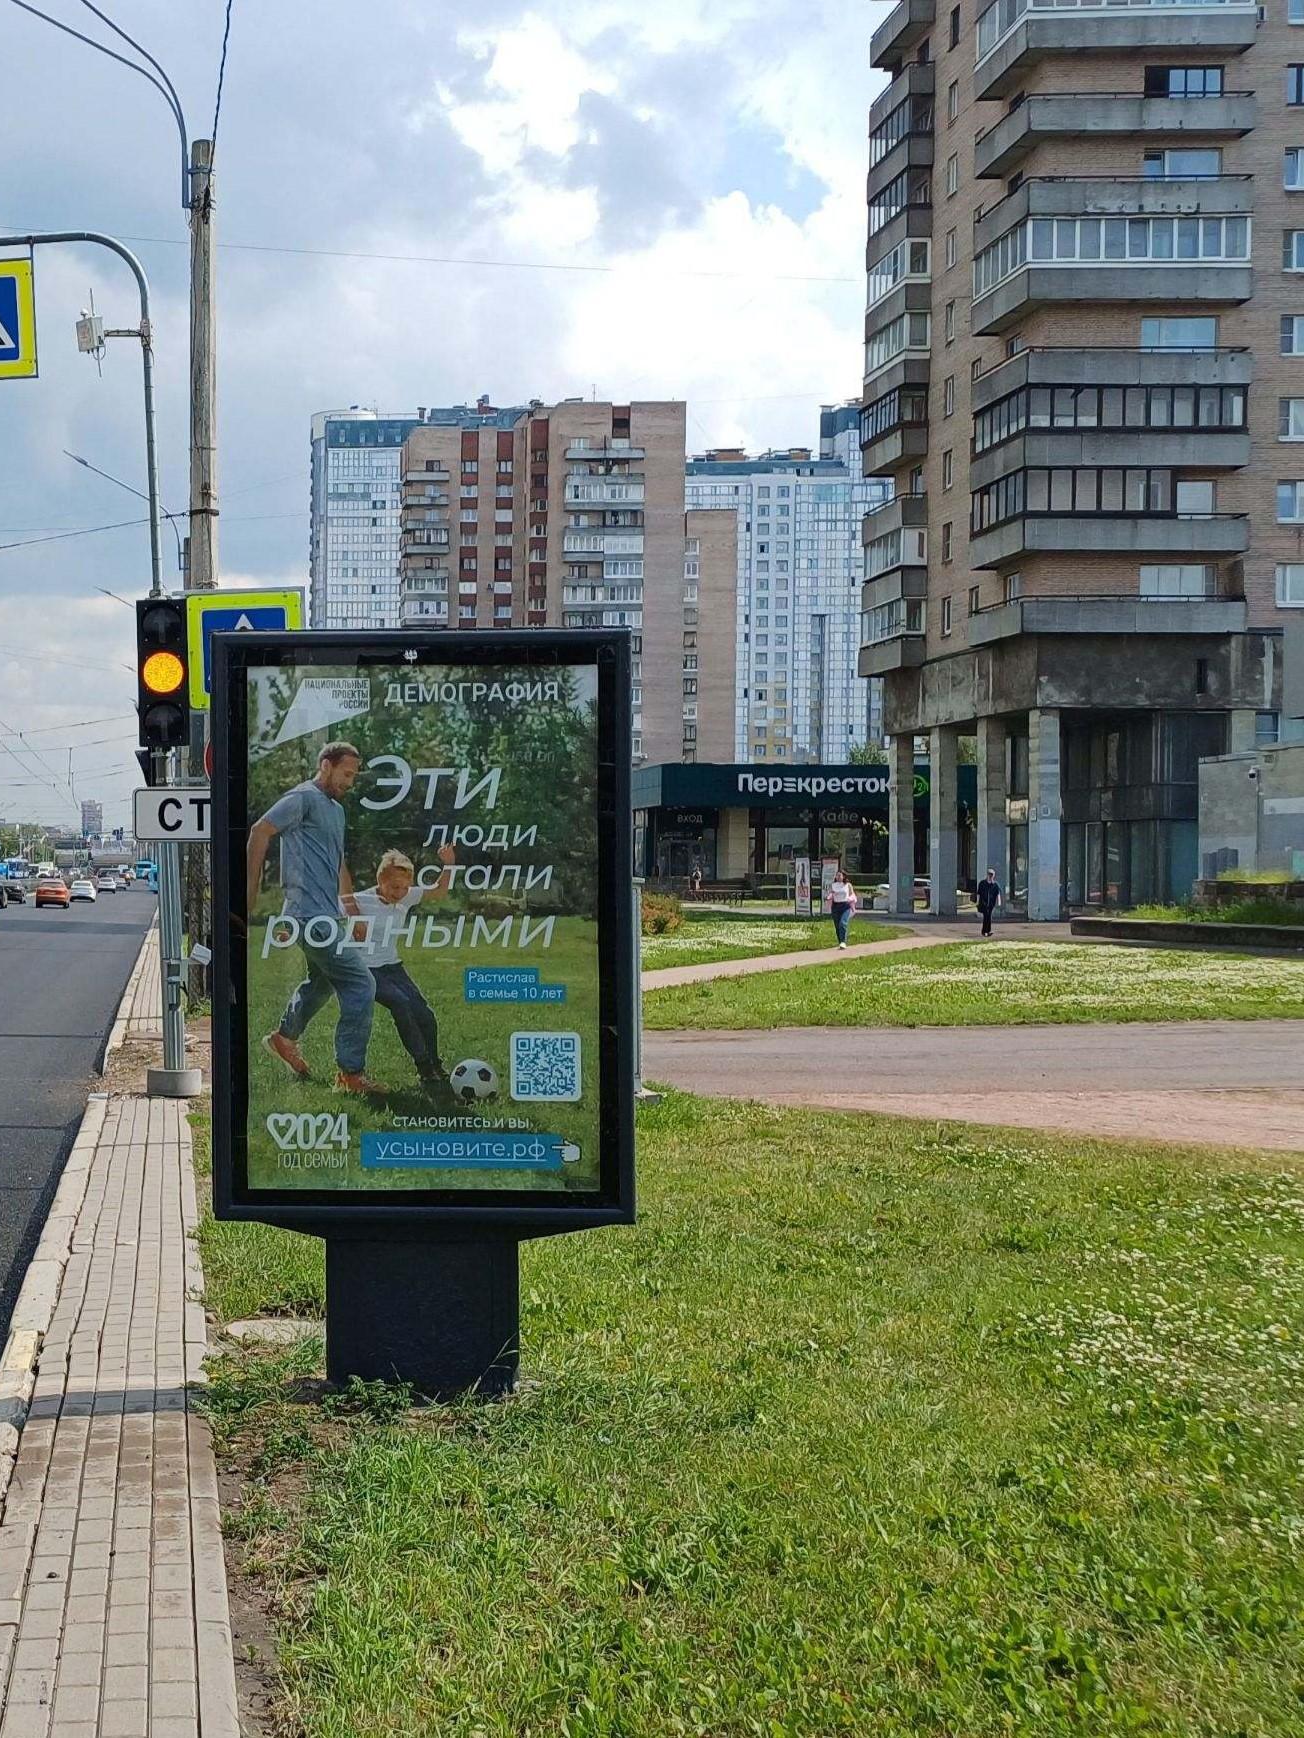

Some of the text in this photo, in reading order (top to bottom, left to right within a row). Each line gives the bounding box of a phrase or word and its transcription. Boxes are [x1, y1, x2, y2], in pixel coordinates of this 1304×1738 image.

[304, 679, 369, 689] НАЦИОНАЛЬНЫЕ
[331, 689, 369, 699] ПРОЕКТЫ
[384, 681, 559, 707] ДЕМОГРАФИЯ
[359, 755, 502, 811] Эти
[819, 809, 860, 823] Кафе
[422, 825, 538, 851] люди
[417, 865, 554, 890] стали
[261, 914, 557, 959] родными
[468, 971, 536, 983] Растислав
[468, 987, 564, 999] в семье 10 лет
[280, 1113, 351, 1150] 2024
[392, 1115, 531, 1130] СТАНОВИТЕСЬ И ВЫ
[376, 1138, 546, 1160] усыновите.рф
